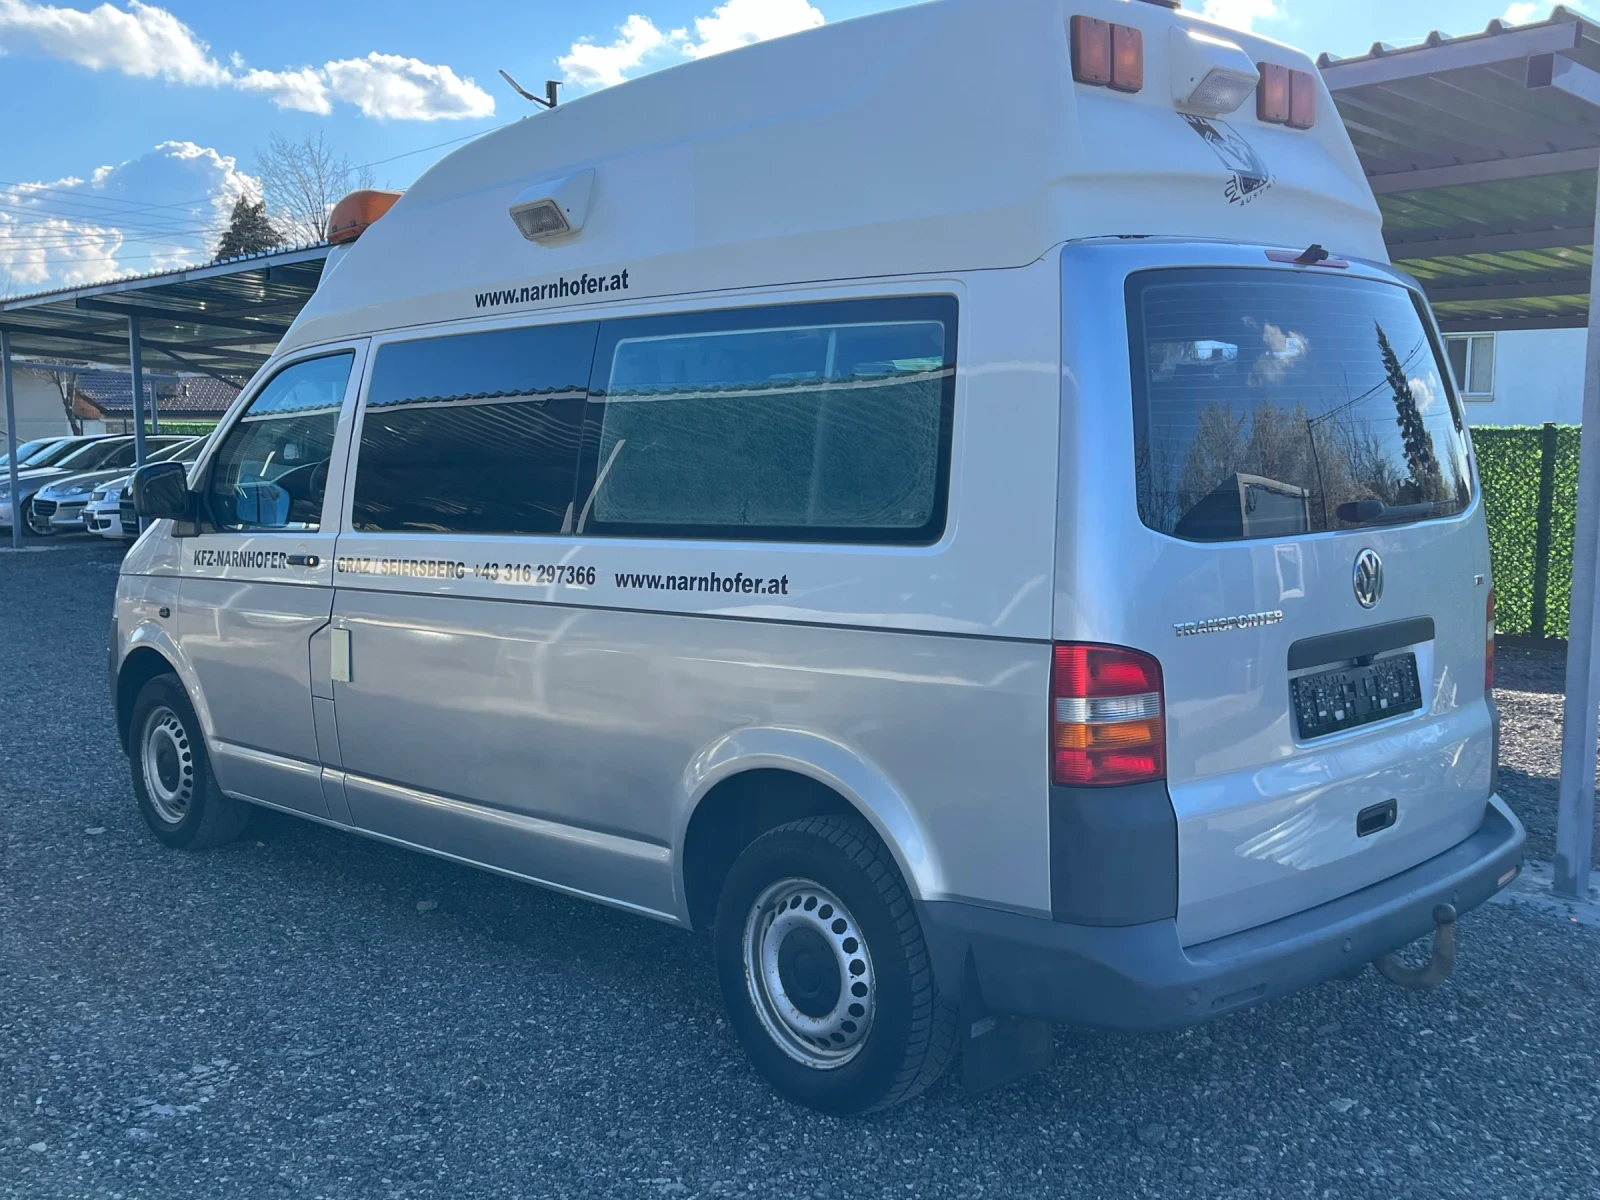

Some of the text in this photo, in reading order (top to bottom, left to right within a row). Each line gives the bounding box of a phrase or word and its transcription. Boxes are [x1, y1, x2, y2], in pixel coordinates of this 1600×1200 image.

[475, 268, 629, 308] www.narnhofer.at
[193, 549, 287, 569] KFZ-NARNHOFER
[337, 556, 371, 574] GRAZ
[381, 559, 465, 579] SEIERSBERG
[473, 561, 499, 581] +43
[504, 563, 531, 583] 316
[536, 563, 596, 586] 297366
[615, 571, 789, 595] www.narnhofer.at
[1173, 609, 1283, 637] TRANSPORTER
